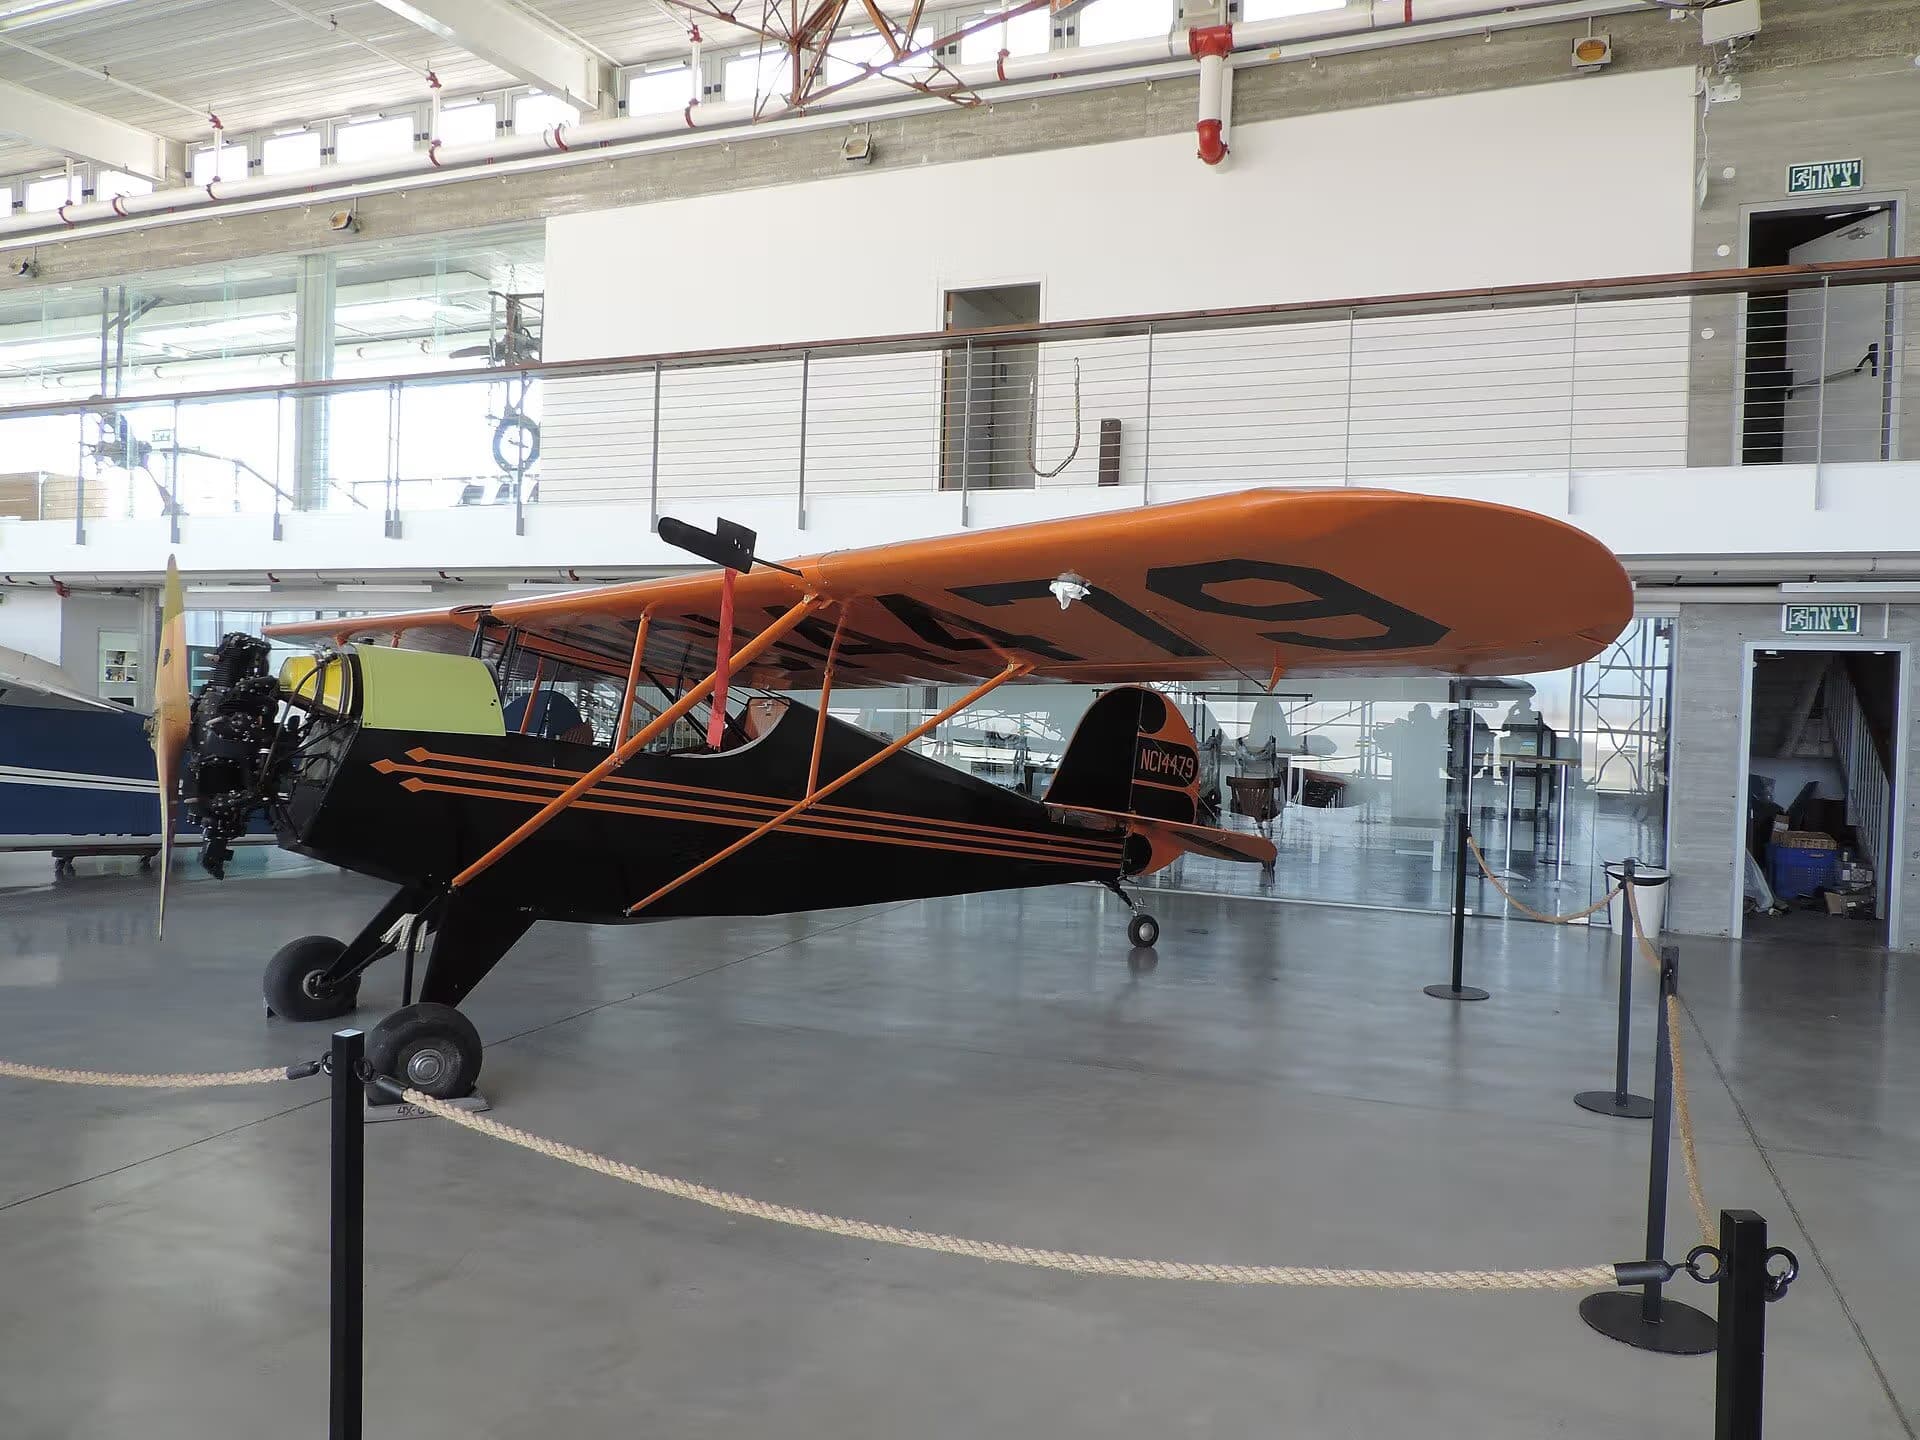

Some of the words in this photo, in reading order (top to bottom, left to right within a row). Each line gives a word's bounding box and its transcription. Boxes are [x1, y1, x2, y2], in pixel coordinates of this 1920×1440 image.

[1813, 162, 1858, 189] יציאה
[1809, 607, 1855, 630] יציאה
[1141, 749, 1194, 778] NC14479
